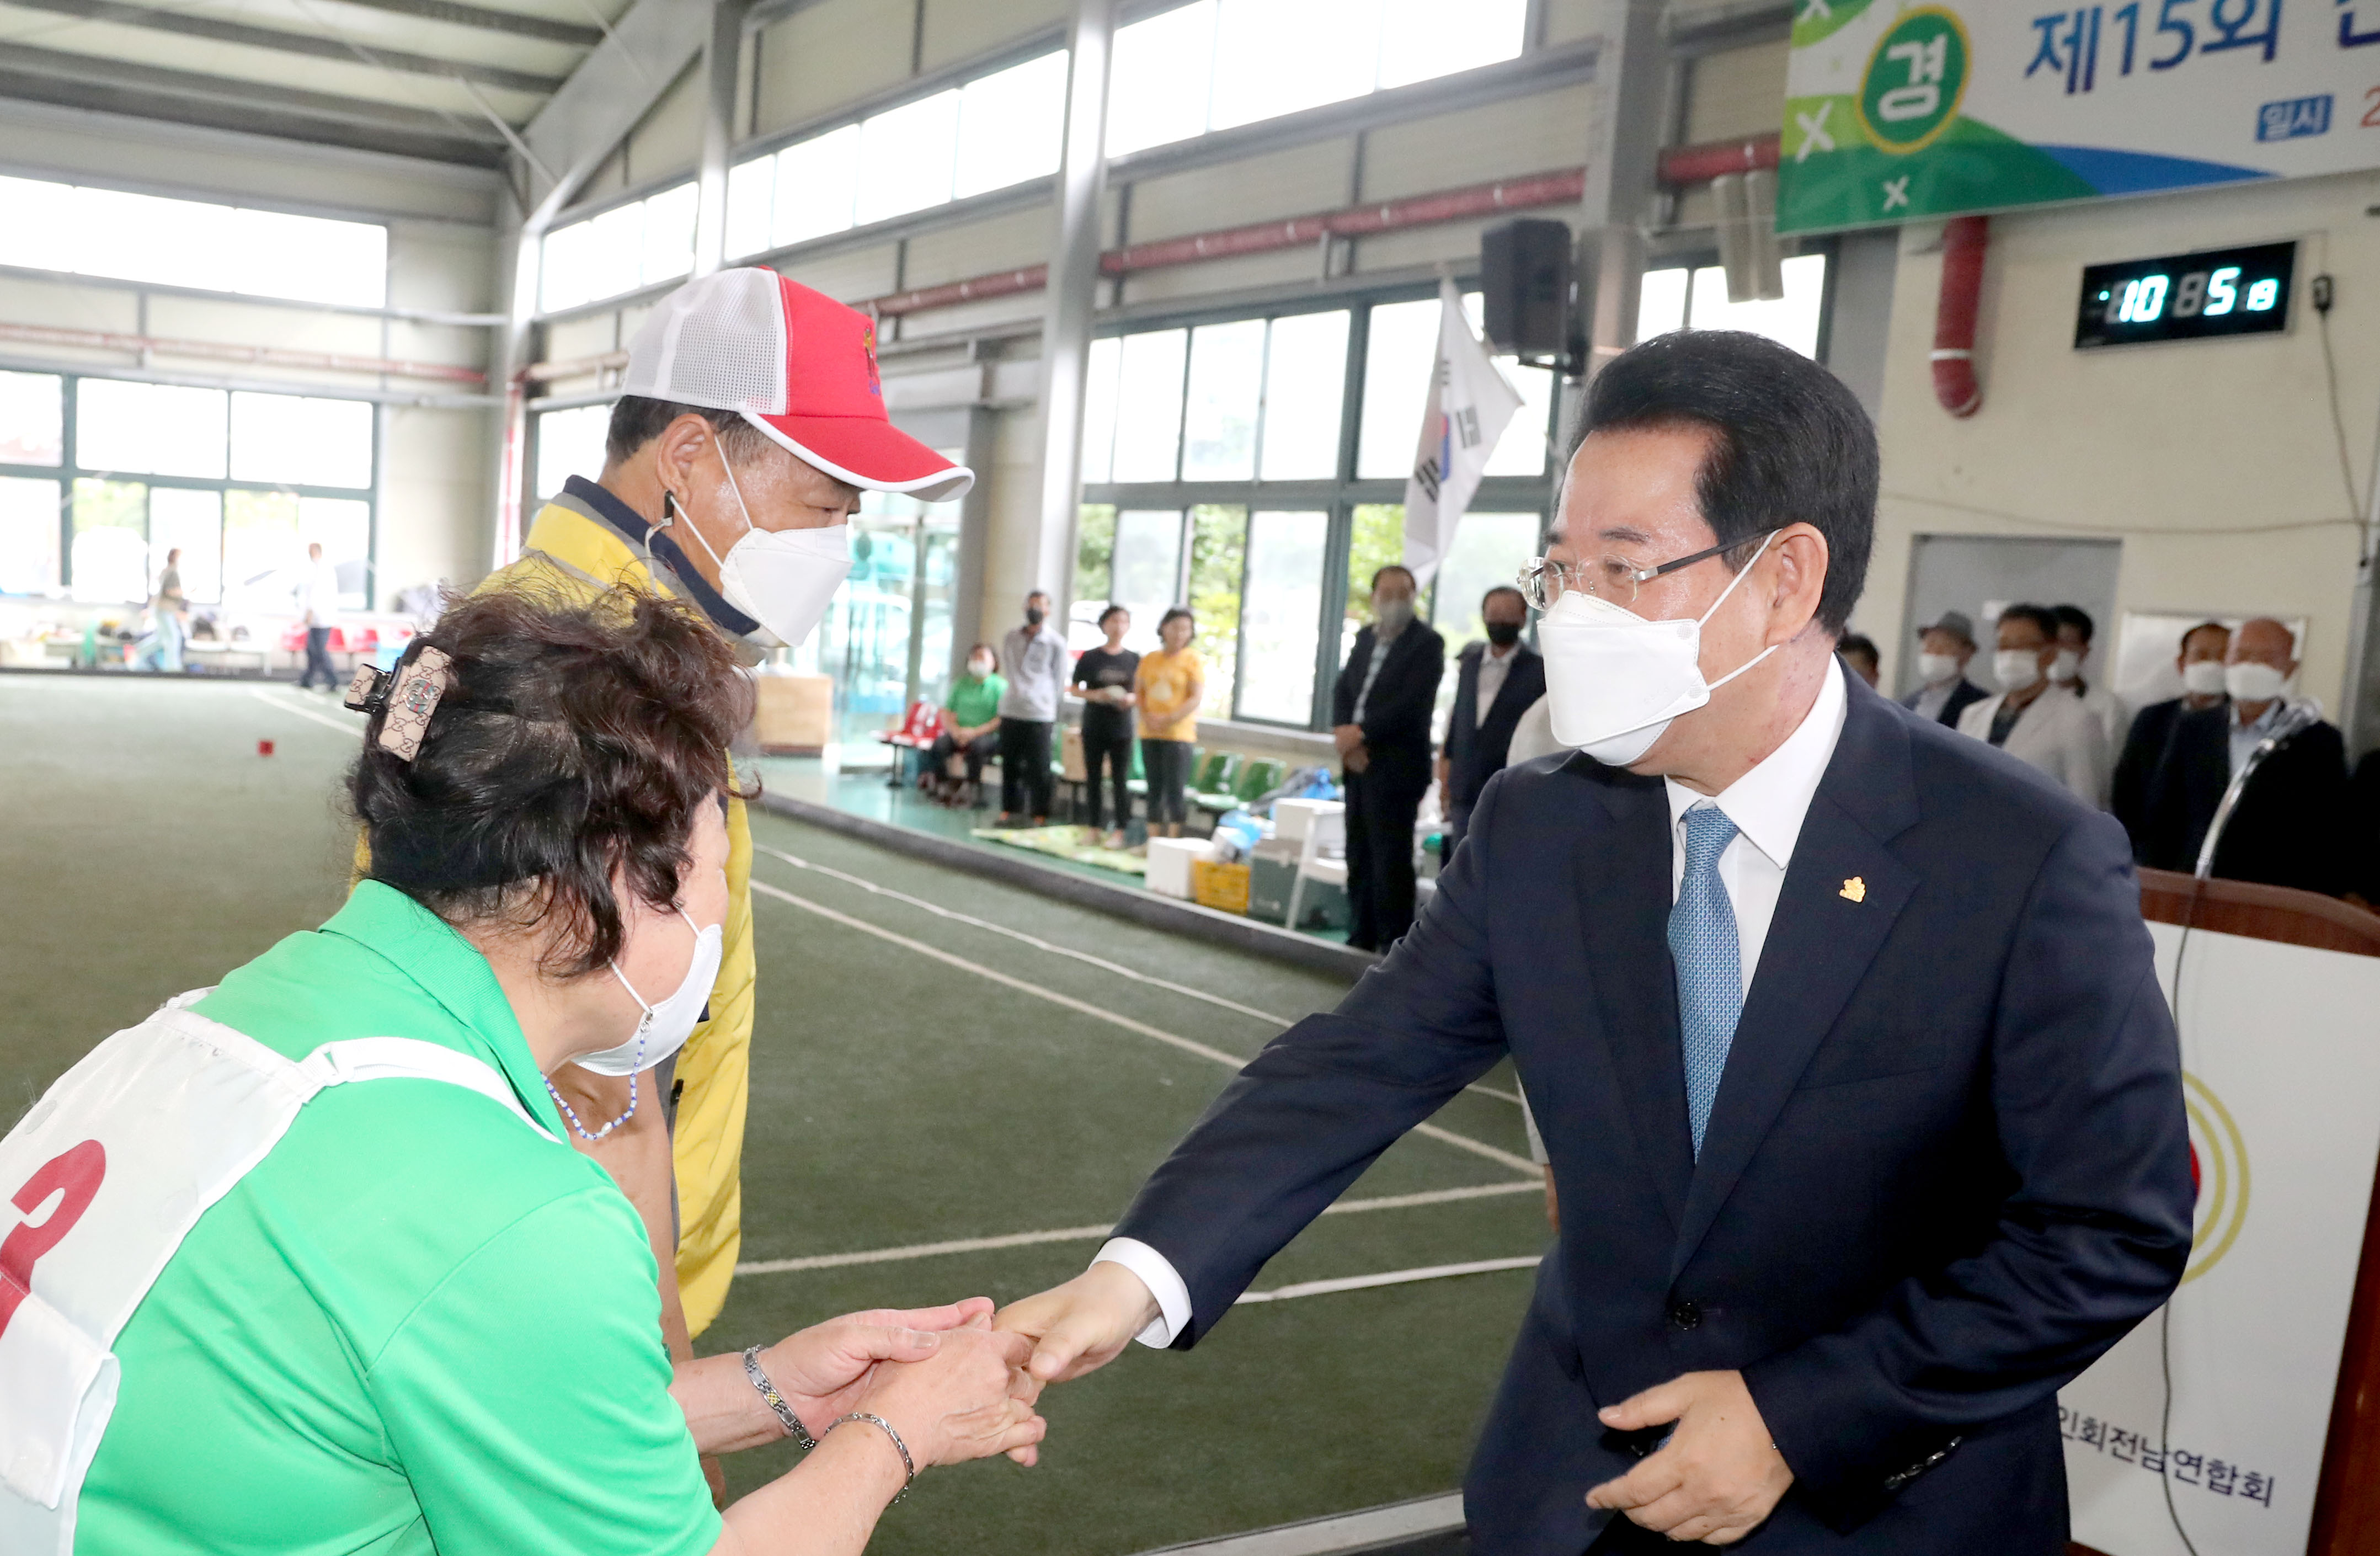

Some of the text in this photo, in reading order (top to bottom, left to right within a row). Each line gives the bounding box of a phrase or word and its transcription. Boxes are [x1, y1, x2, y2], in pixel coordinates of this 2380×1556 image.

[1878, 33, 1947, 122] 경
[2262, 95, 2327, 141] 일시
[2118, 274, 2169, 323] 10
